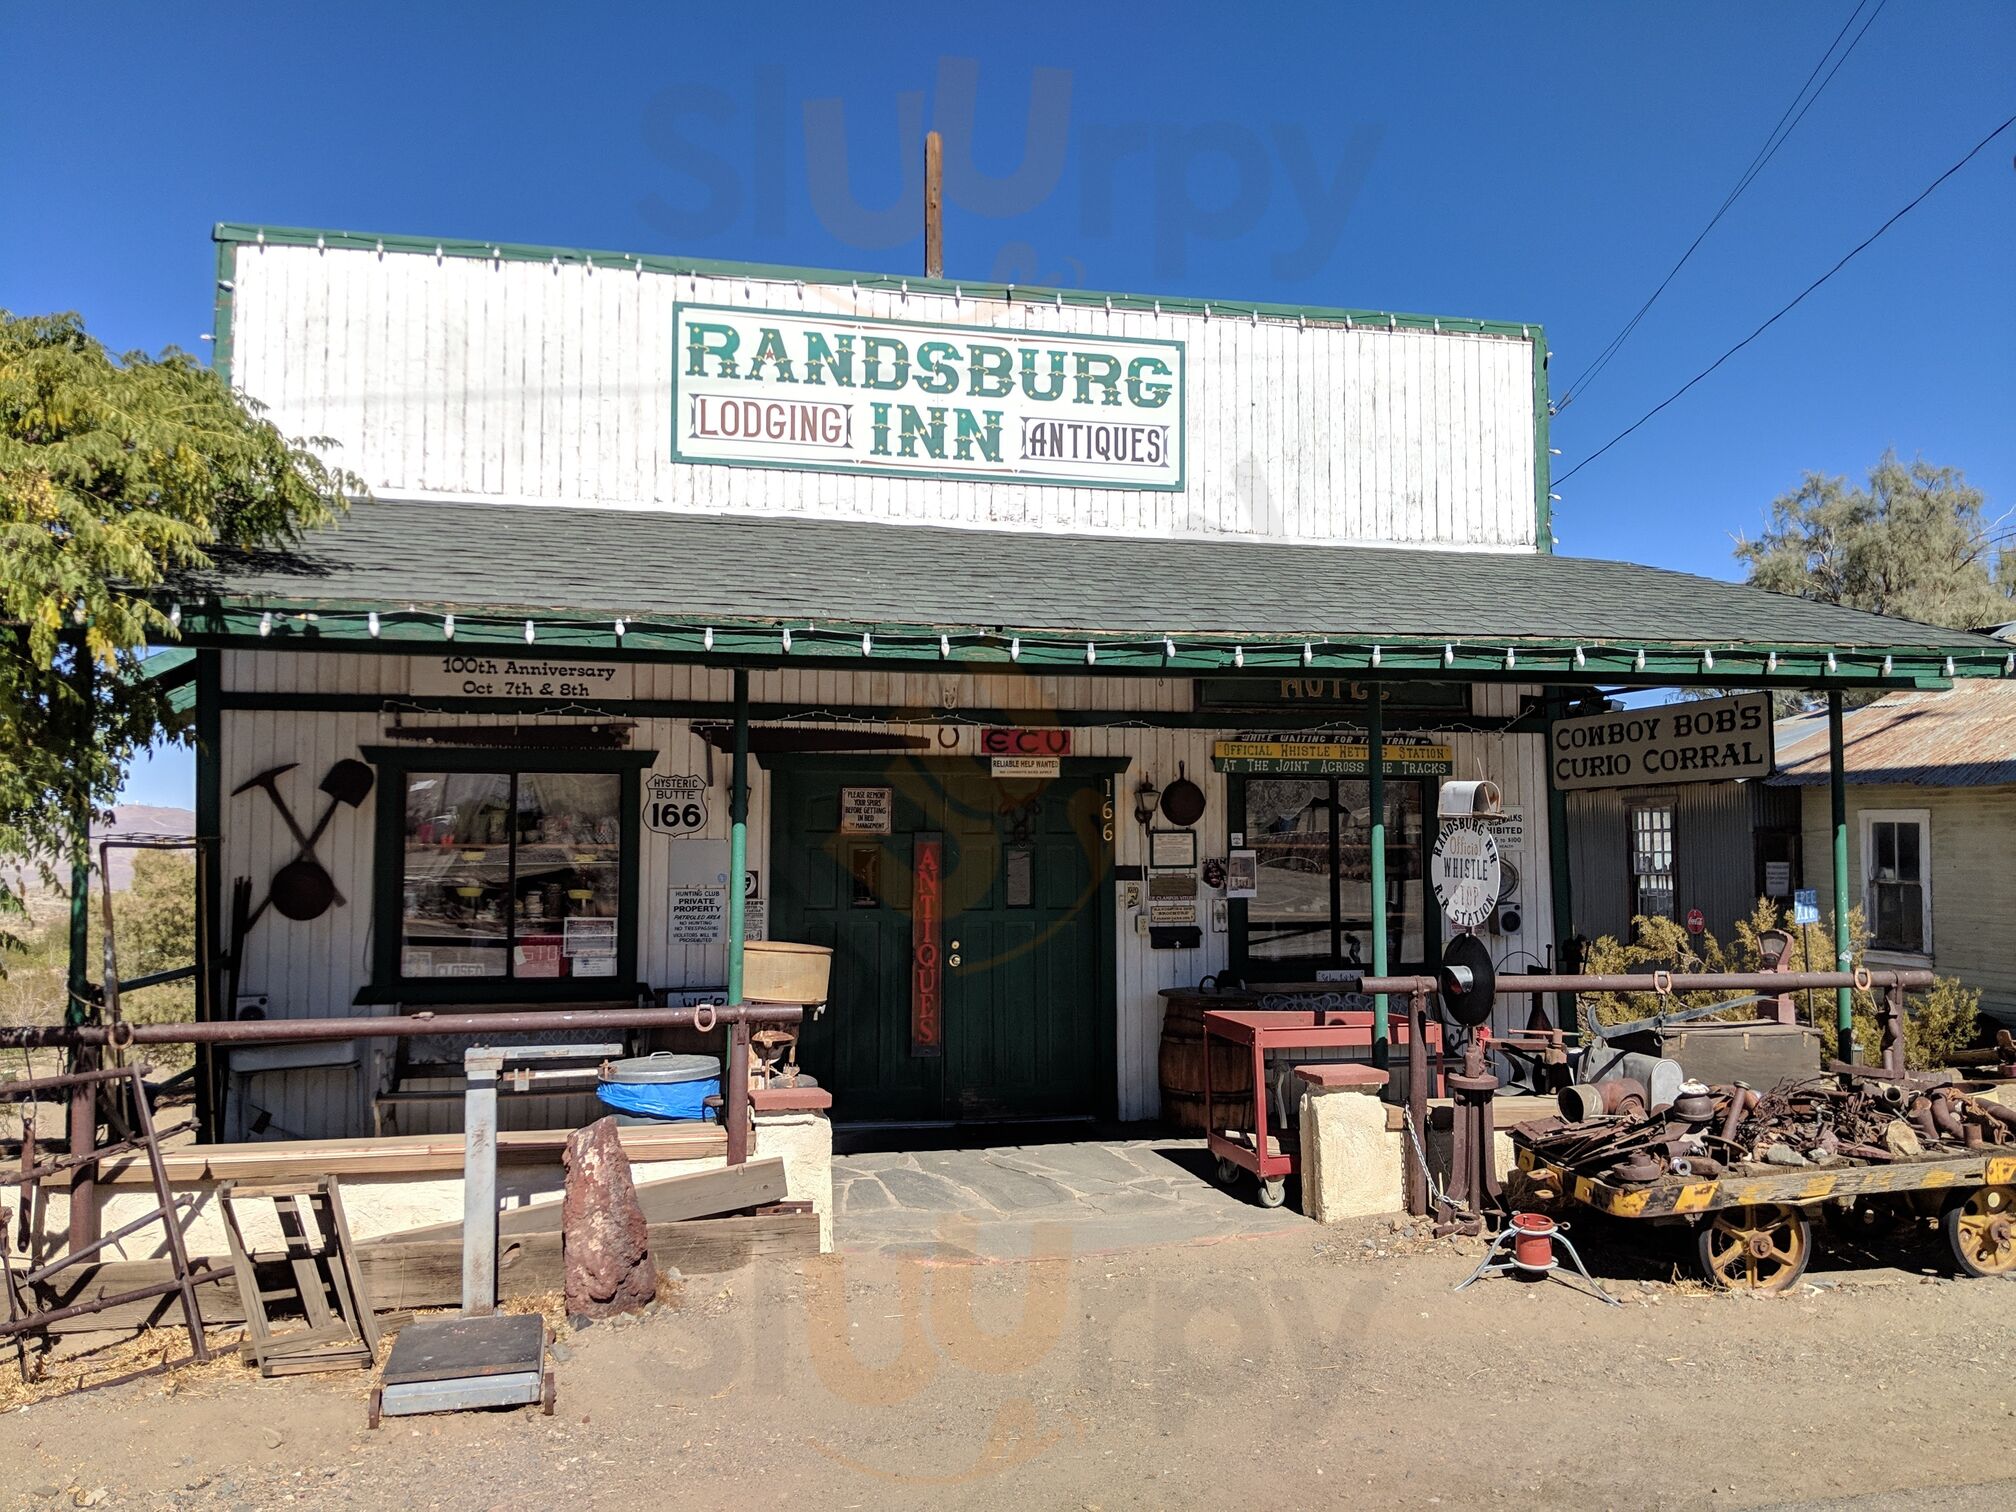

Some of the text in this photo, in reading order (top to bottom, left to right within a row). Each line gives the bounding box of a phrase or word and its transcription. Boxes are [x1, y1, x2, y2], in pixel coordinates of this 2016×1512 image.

[685, 321, 1173, 409] RANDSBURG
[700, 398, 842, 443] LODGING
[869, 402, 1004, 463] INN
[1029, 422, 1161, 463] ANTIQUES
[442, 656, 616, 681] 100th Anniversary
[462, 680, 590, 697] Oct 7th & 8th
[1556, 701, 1762, 750] COWBOY BOB'S
[1241, 734, 1273, 742] WHILE
[1279, 735, 1327, 743] WAITING
[1333, 736, 1353, 744] FOR
[1385, 737, 1416, 745] TRAIN
[1223, 743, 1445, 759] OFFICIAL WHISTLE WETTG STATION
[993, 760, 1058, 768] RELIABLE HELP WANTED
[1222, 758, 1237, 772] AT
[1246, 758, 1269, 772] THE
[1275, 760, 1310, 773] JOINT
[1320, 760, 1365, 773] ACROSS
[1402, 761, 1447, 774] TRACKS
[1556, 742, 1763, 780] CURIO CORRAL
[654, 778, 698, 788] HYSTERIC
[656, 790, 696, 800] BUTTE
[847, 791, 865, 799] PLEASE
[854, 799, 882, 807] YOUR SPURS
[652, 803, 702, 828] 166
[846, 806, 887, 815] BEFORE GETTING
[857, 814, 875, 822] IN BED
[1433, 817, 1485, 857] RANDSBURG
[1443, 857, 1489, 880] WHISTLE
[1453, 885, 1480, 907] STOP
[1794, 890, 1817, 904] FREE
[1453, 893, 1496, 926] STATION
[1796, 905, 1816, 921] AIR
[917, 848, 938, 1042] ANTIQUES
